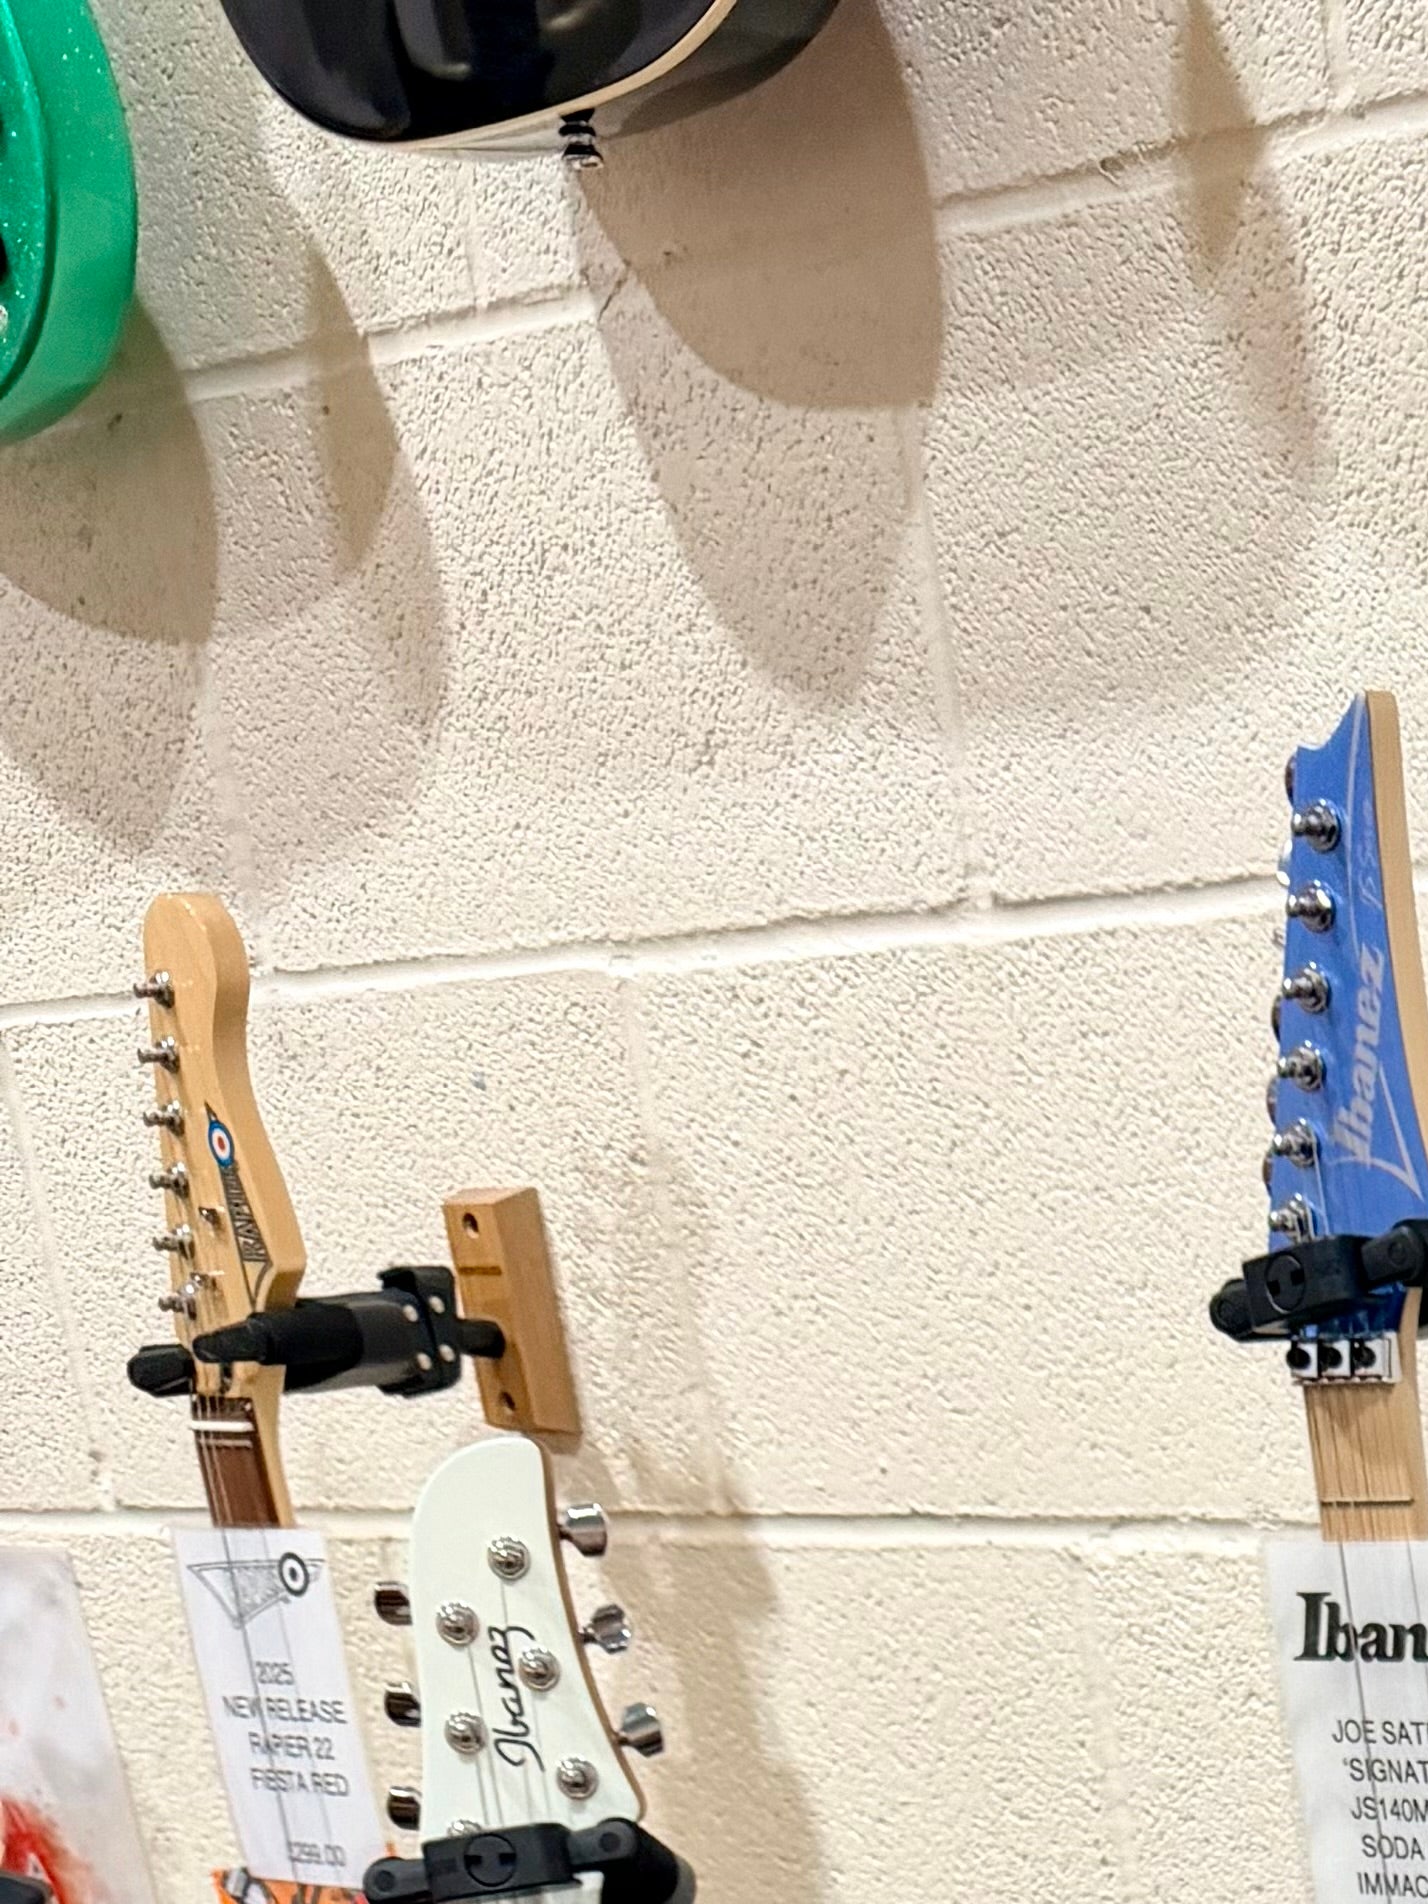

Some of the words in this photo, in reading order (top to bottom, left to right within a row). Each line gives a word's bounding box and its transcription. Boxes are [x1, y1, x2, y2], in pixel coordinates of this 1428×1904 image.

[1331, 942, 1385, 1168] Ibanez
[255, 1661, 294, 1686] 2025
[222, 1695, 260, 1720] NEW
[266, 1697, 348, 1724] RELEASE
[487, 1625, 545, 1772] Ibanez
[1331, 1719, 1375, 1744] JOE
[248, 1732, 311, 1760] RAPIER
[313, 1737, 335, 1761] 22
[251, 1768, 308, 1793] FIESTA
[312, 1771, 348, 1797] RED
[1362, 1836, 1425, 1861] SODA
